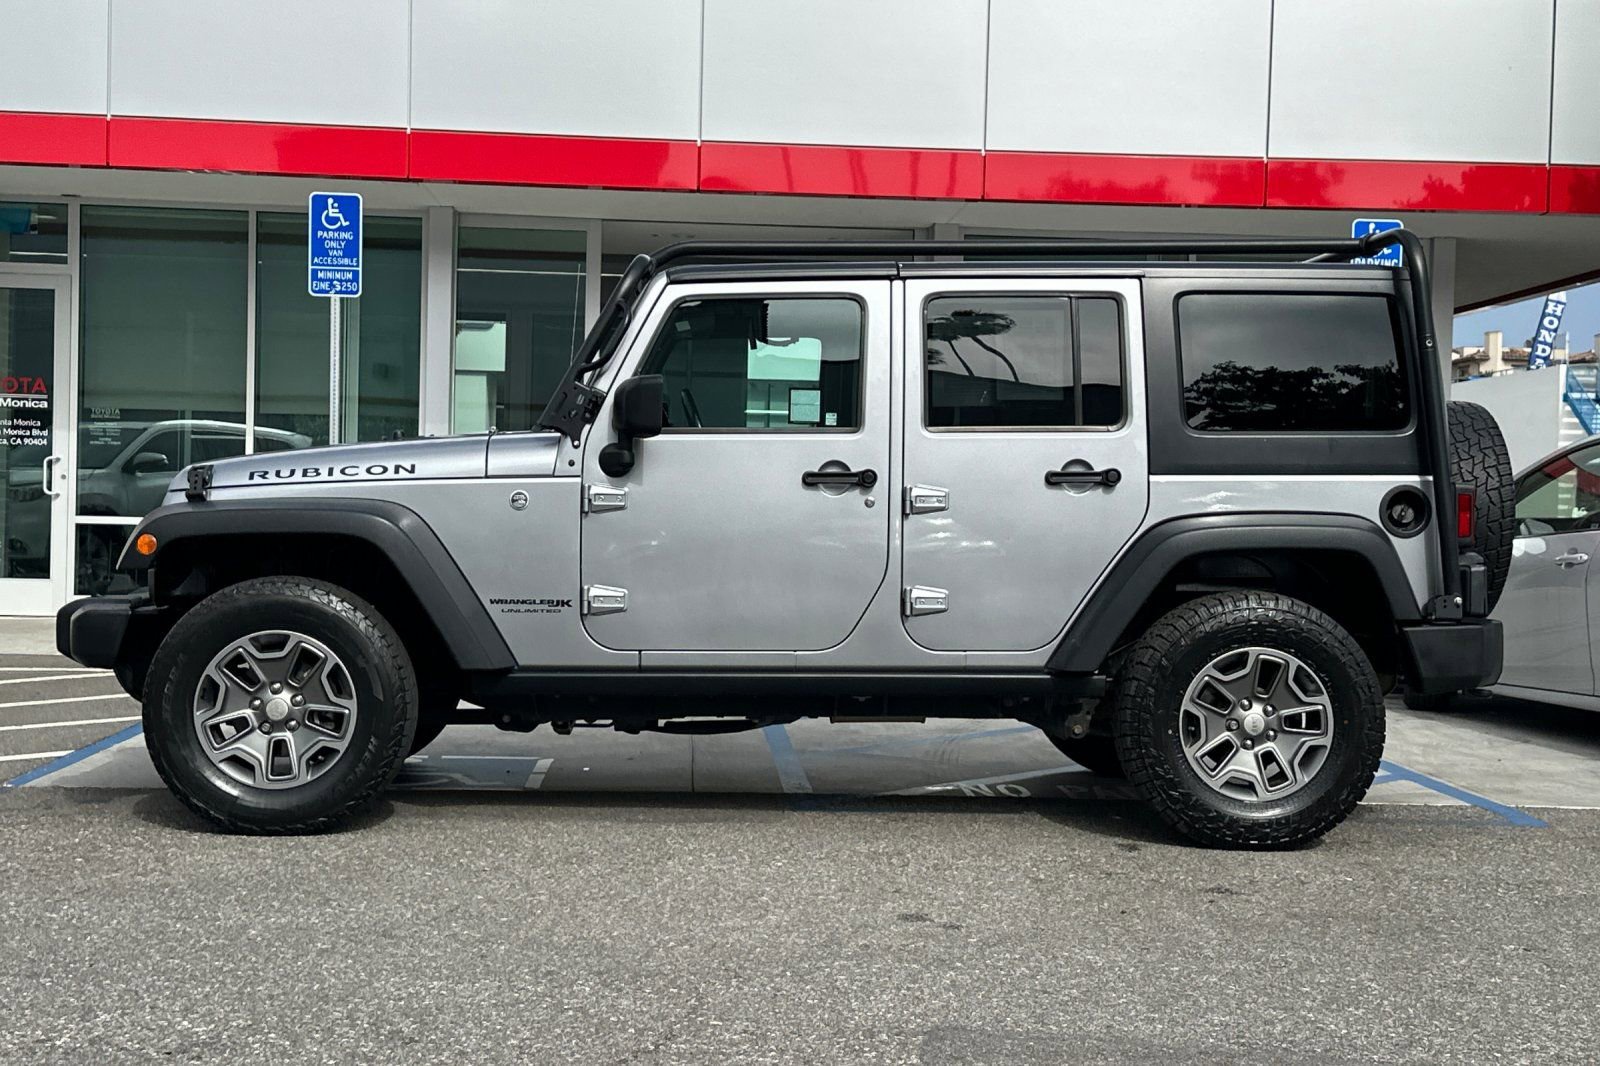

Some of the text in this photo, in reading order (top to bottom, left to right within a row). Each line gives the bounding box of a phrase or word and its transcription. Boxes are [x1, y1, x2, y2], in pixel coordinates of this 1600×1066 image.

[317, 230, 354, 240] PARKING
[324, 240, 347, 249] ONLY
[328, 249, 343, 257] VAN
[313, 257, 358, 266] ACCESSIBLE
[317, 270, 353, 280] MINIMUM
[312, 280, 331, 291] FINE
[0, 397, 49, 409] Monica
[13, 418, 41, 427] Monica
[3, 427, 49, 437] Monica Blvd
[10, 437, 22, 445] CA
[23, 438, 48, 446] 90404
[248, 463, 417, 481] RUBICON
